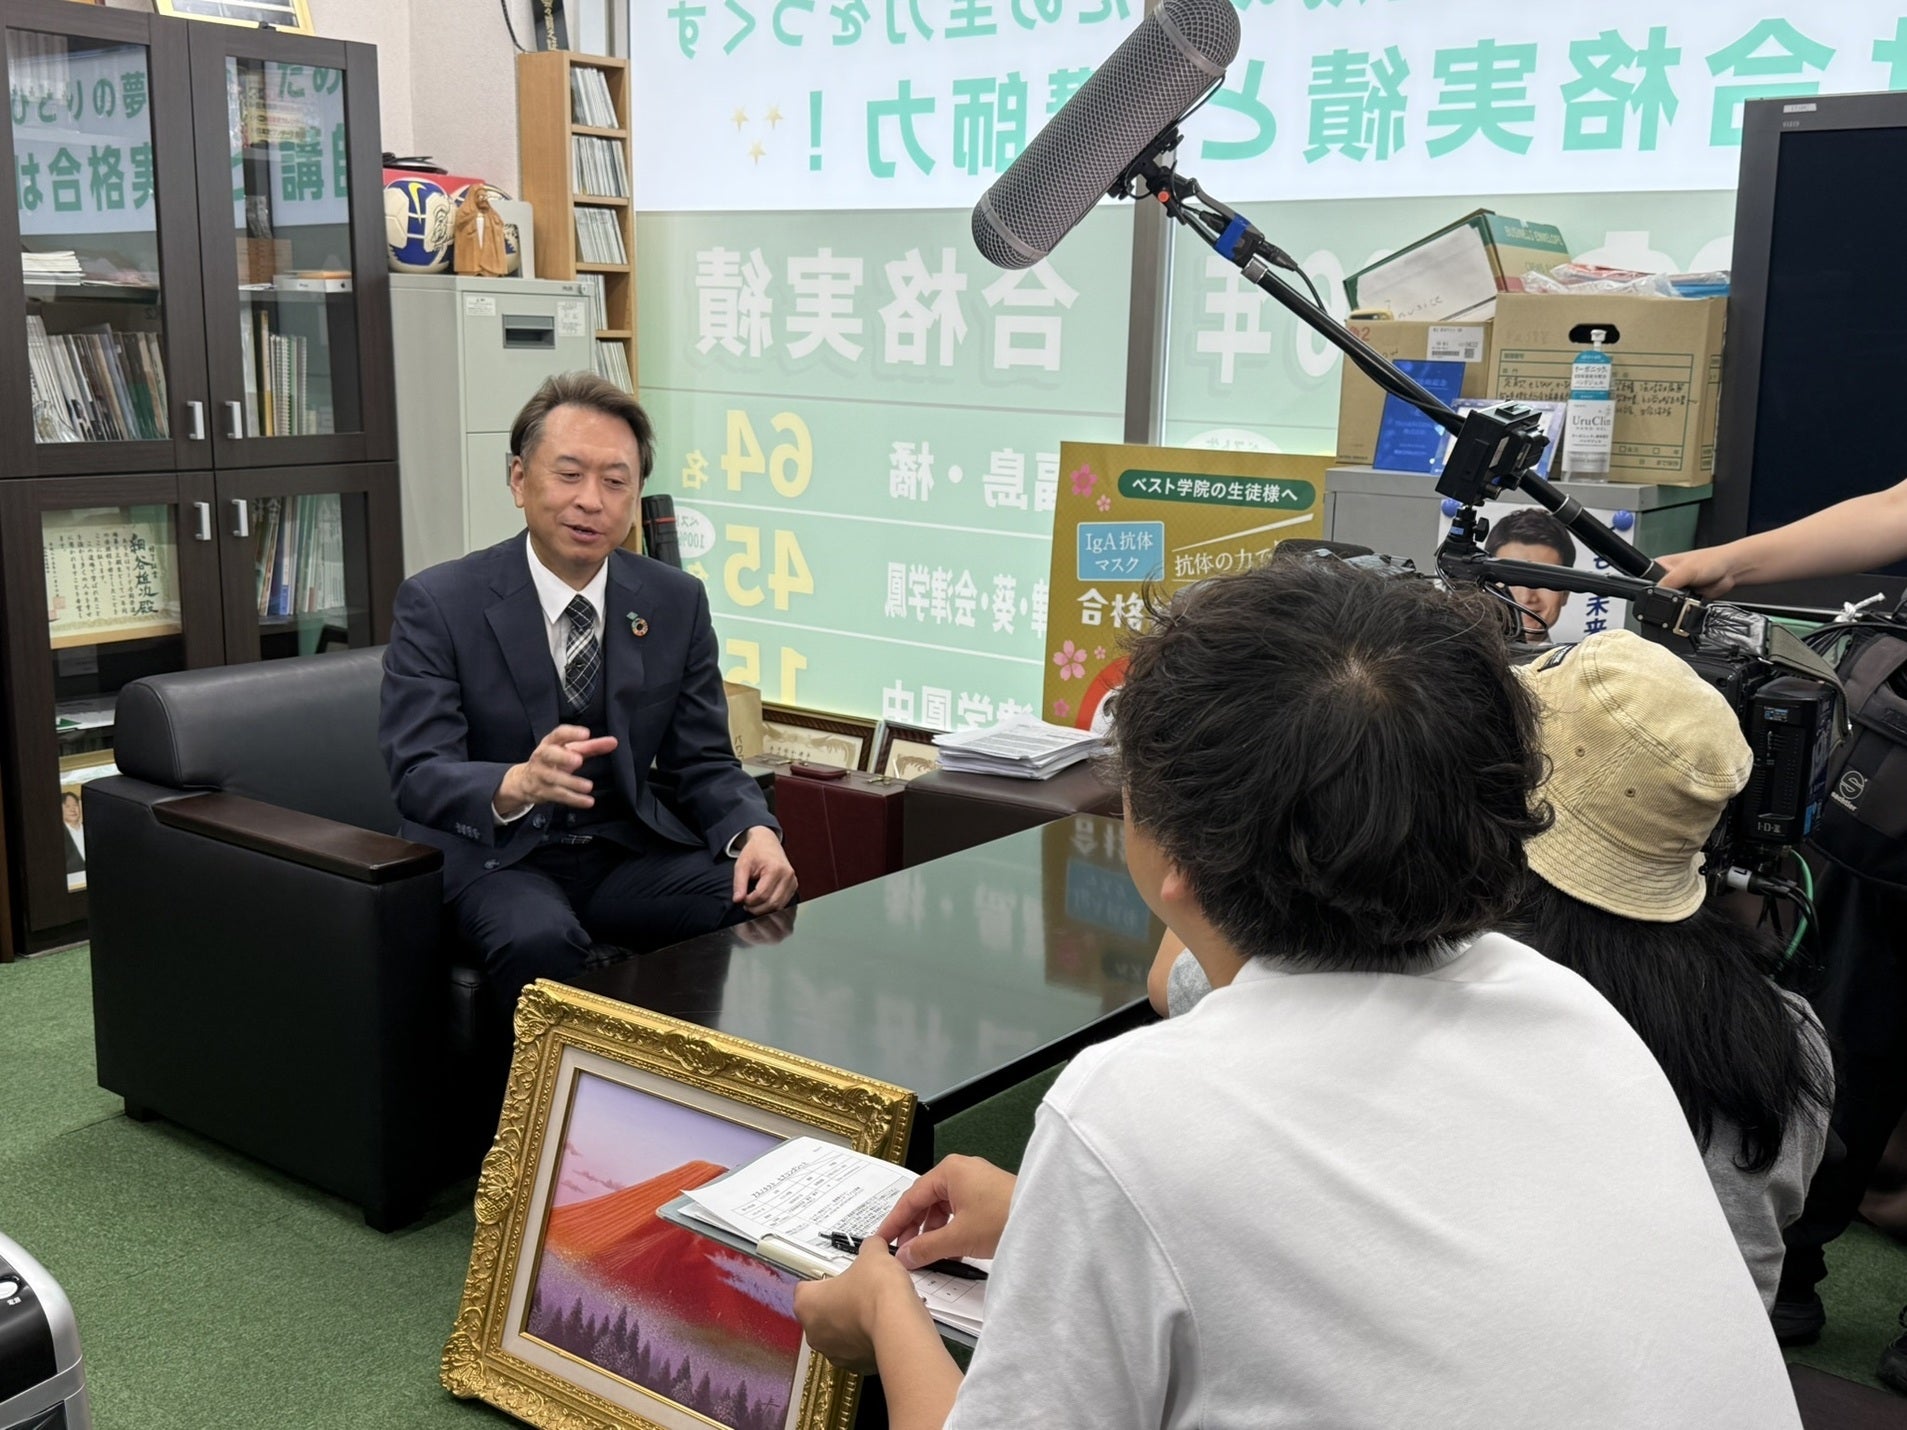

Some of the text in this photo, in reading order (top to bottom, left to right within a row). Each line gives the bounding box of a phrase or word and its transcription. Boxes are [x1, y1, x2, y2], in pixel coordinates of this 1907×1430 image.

[1132, 477, 1298, 503] ベスト学院の生徒様へ
[1095, 556, 1139, 573] マスク
